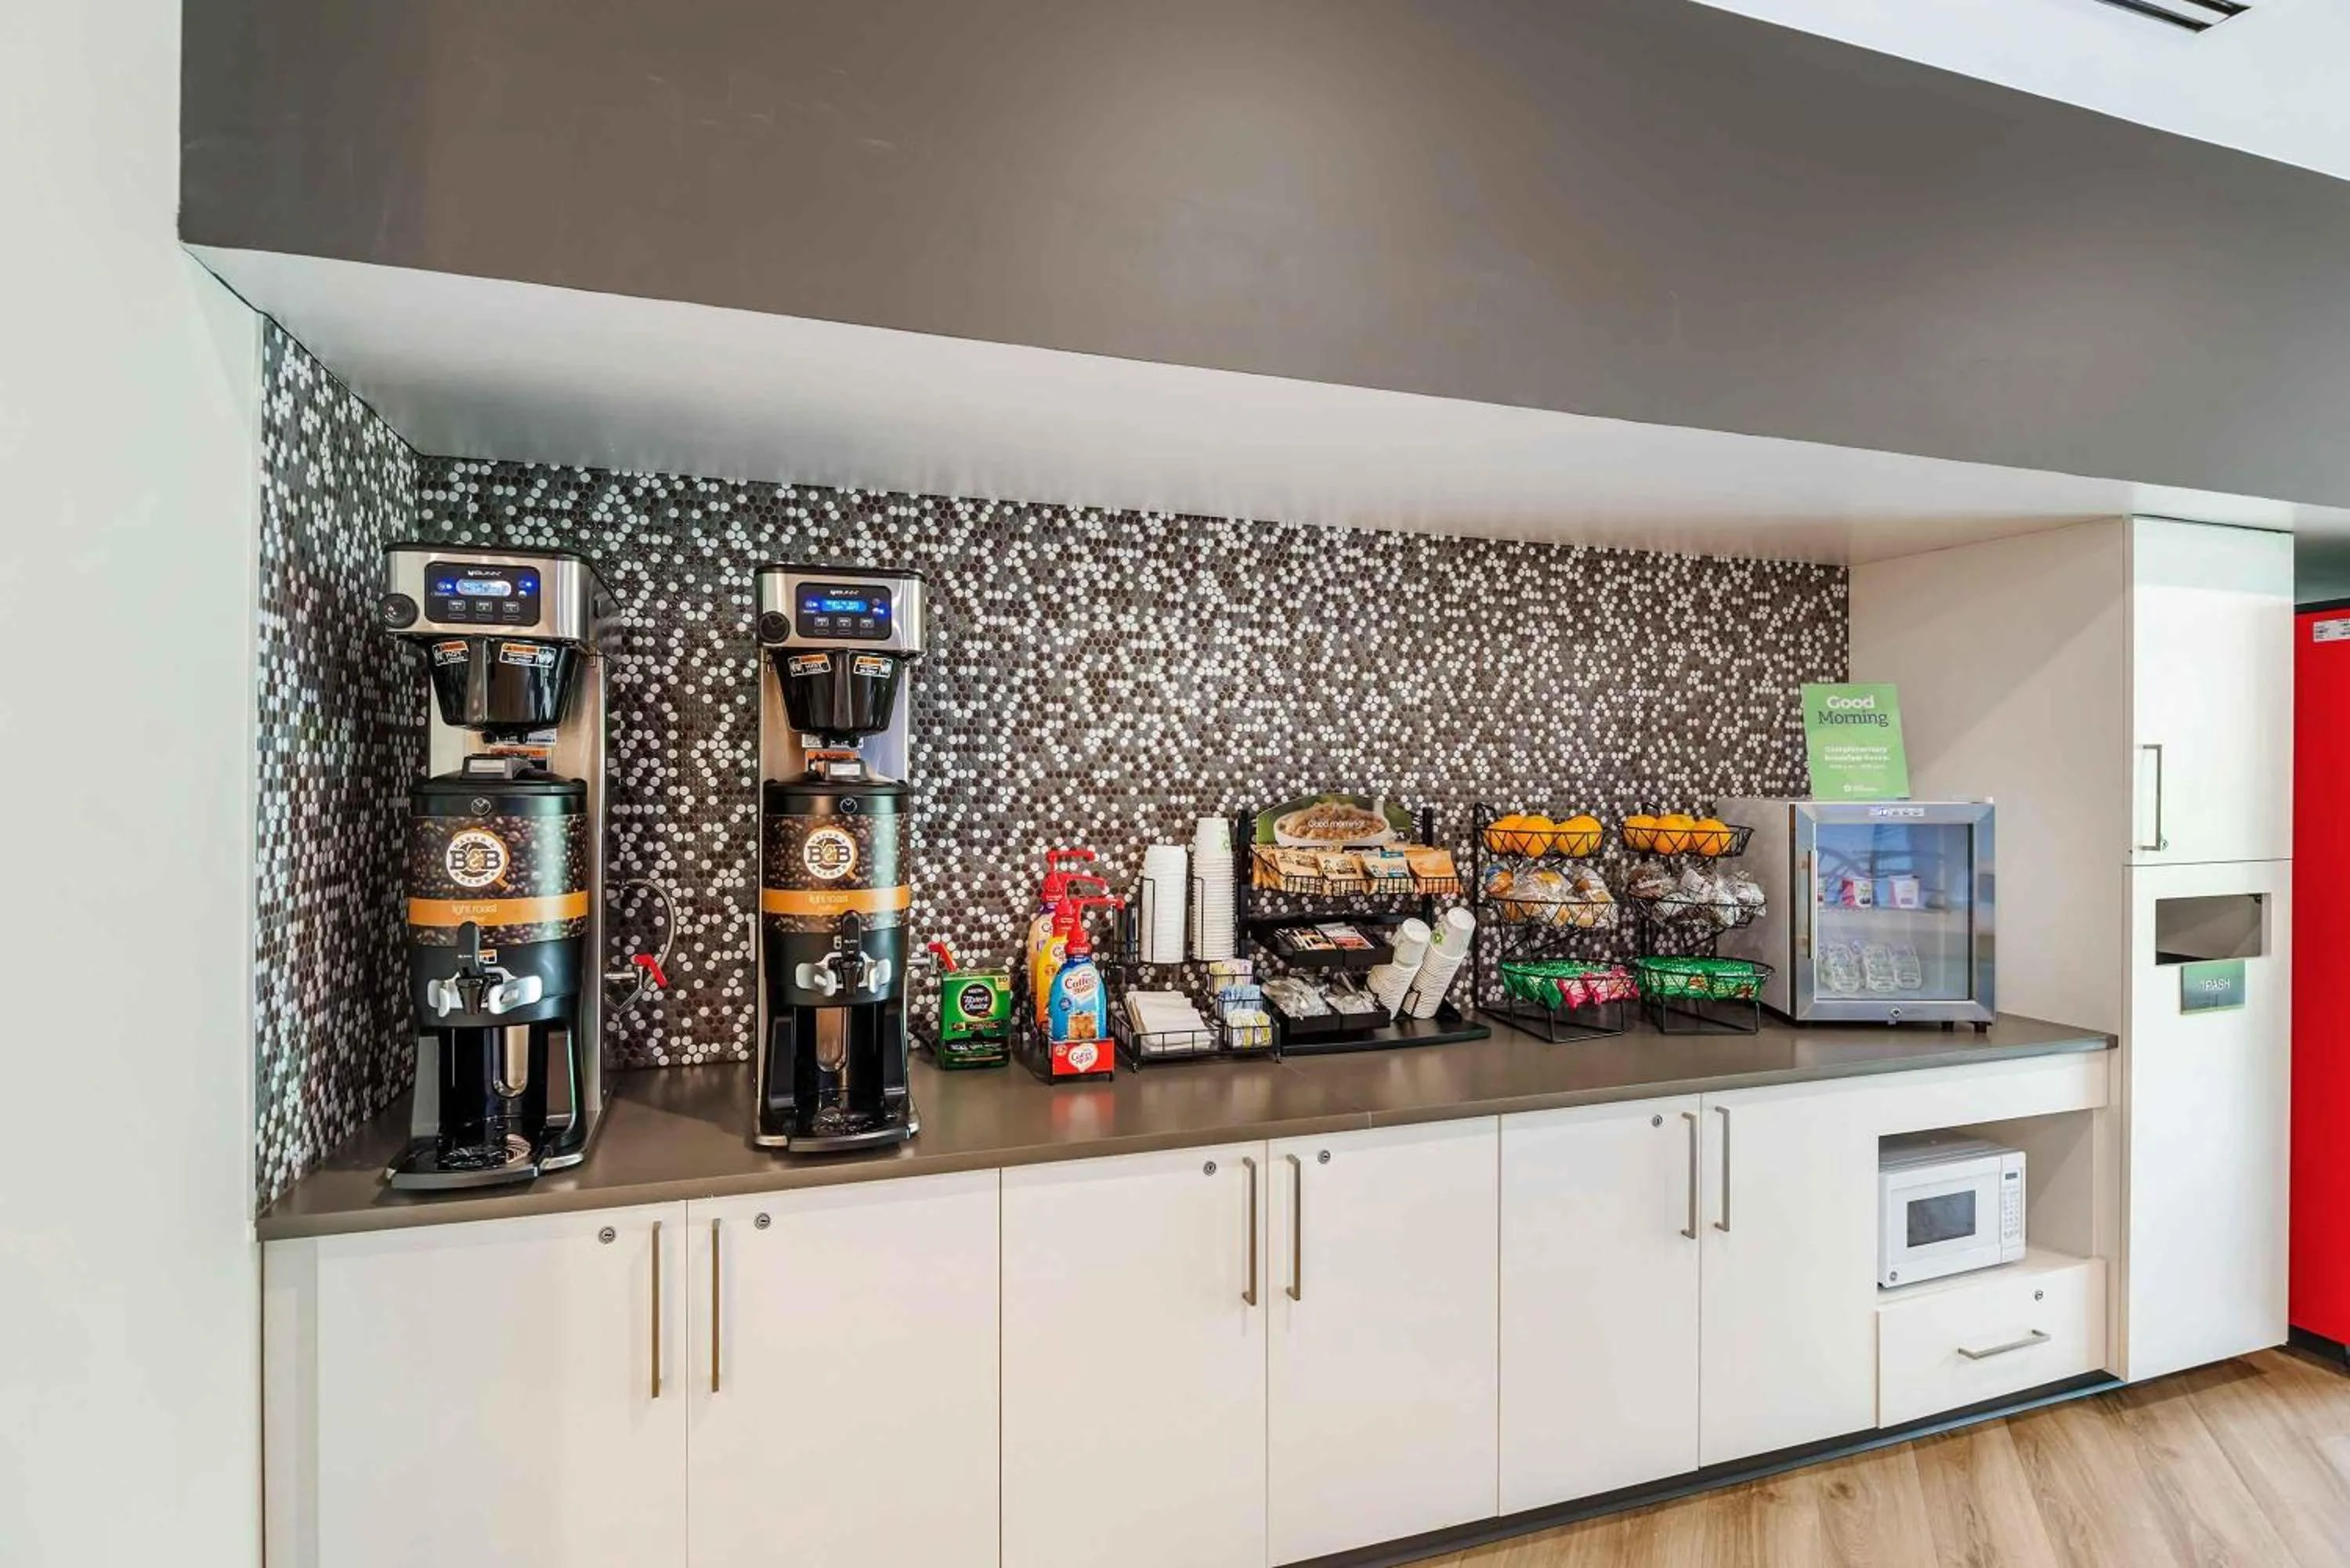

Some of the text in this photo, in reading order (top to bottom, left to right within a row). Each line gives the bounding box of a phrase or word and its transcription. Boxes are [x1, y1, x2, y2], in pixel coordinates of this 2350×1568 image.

[1827, 695, 1875, 709] Good
[1818, 710, 1889, 727] Morning
[1307, 818, 1329, 828] Good
[2200, 978, 2231, 992] TRASH
